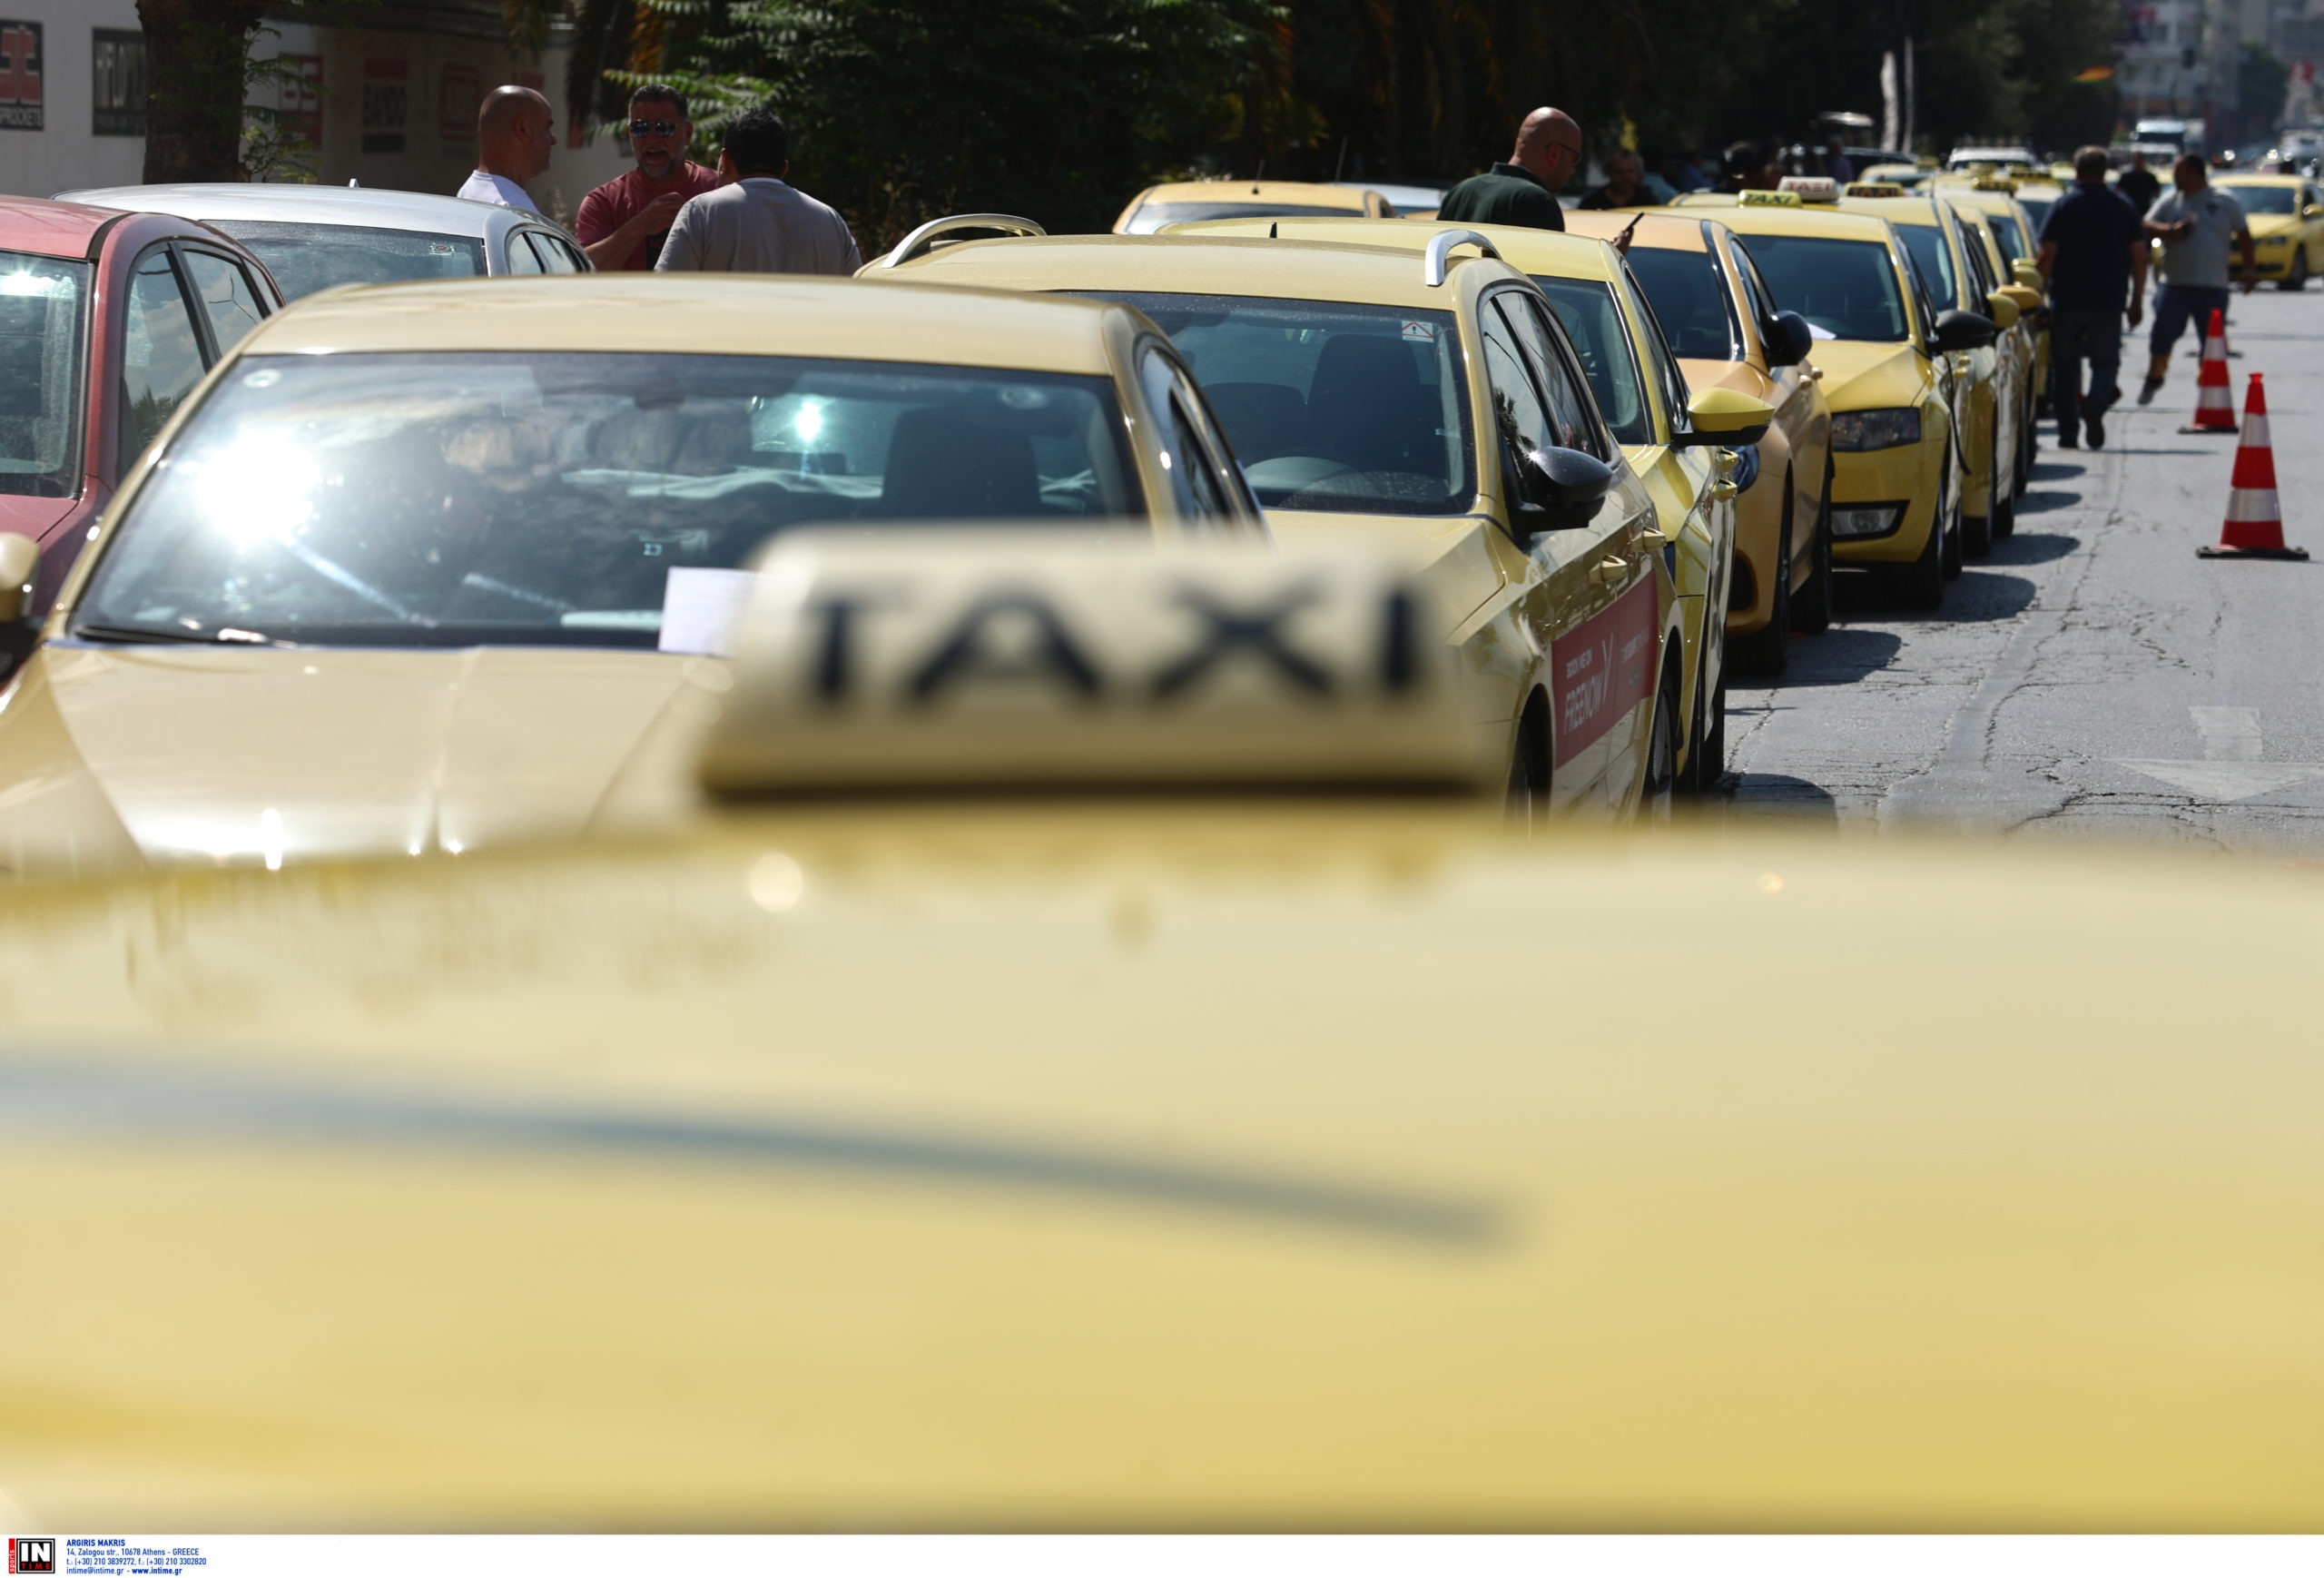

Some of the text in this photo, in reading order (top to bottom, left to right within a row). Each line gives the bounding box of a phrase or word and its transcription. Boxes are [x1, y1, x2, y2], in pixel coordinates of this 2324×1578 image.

[1745, 193, 1794, 205] TAXI
[797, 579, 1420, 703] TAXI
[1562, 669, 1604, 737] FREENOW
